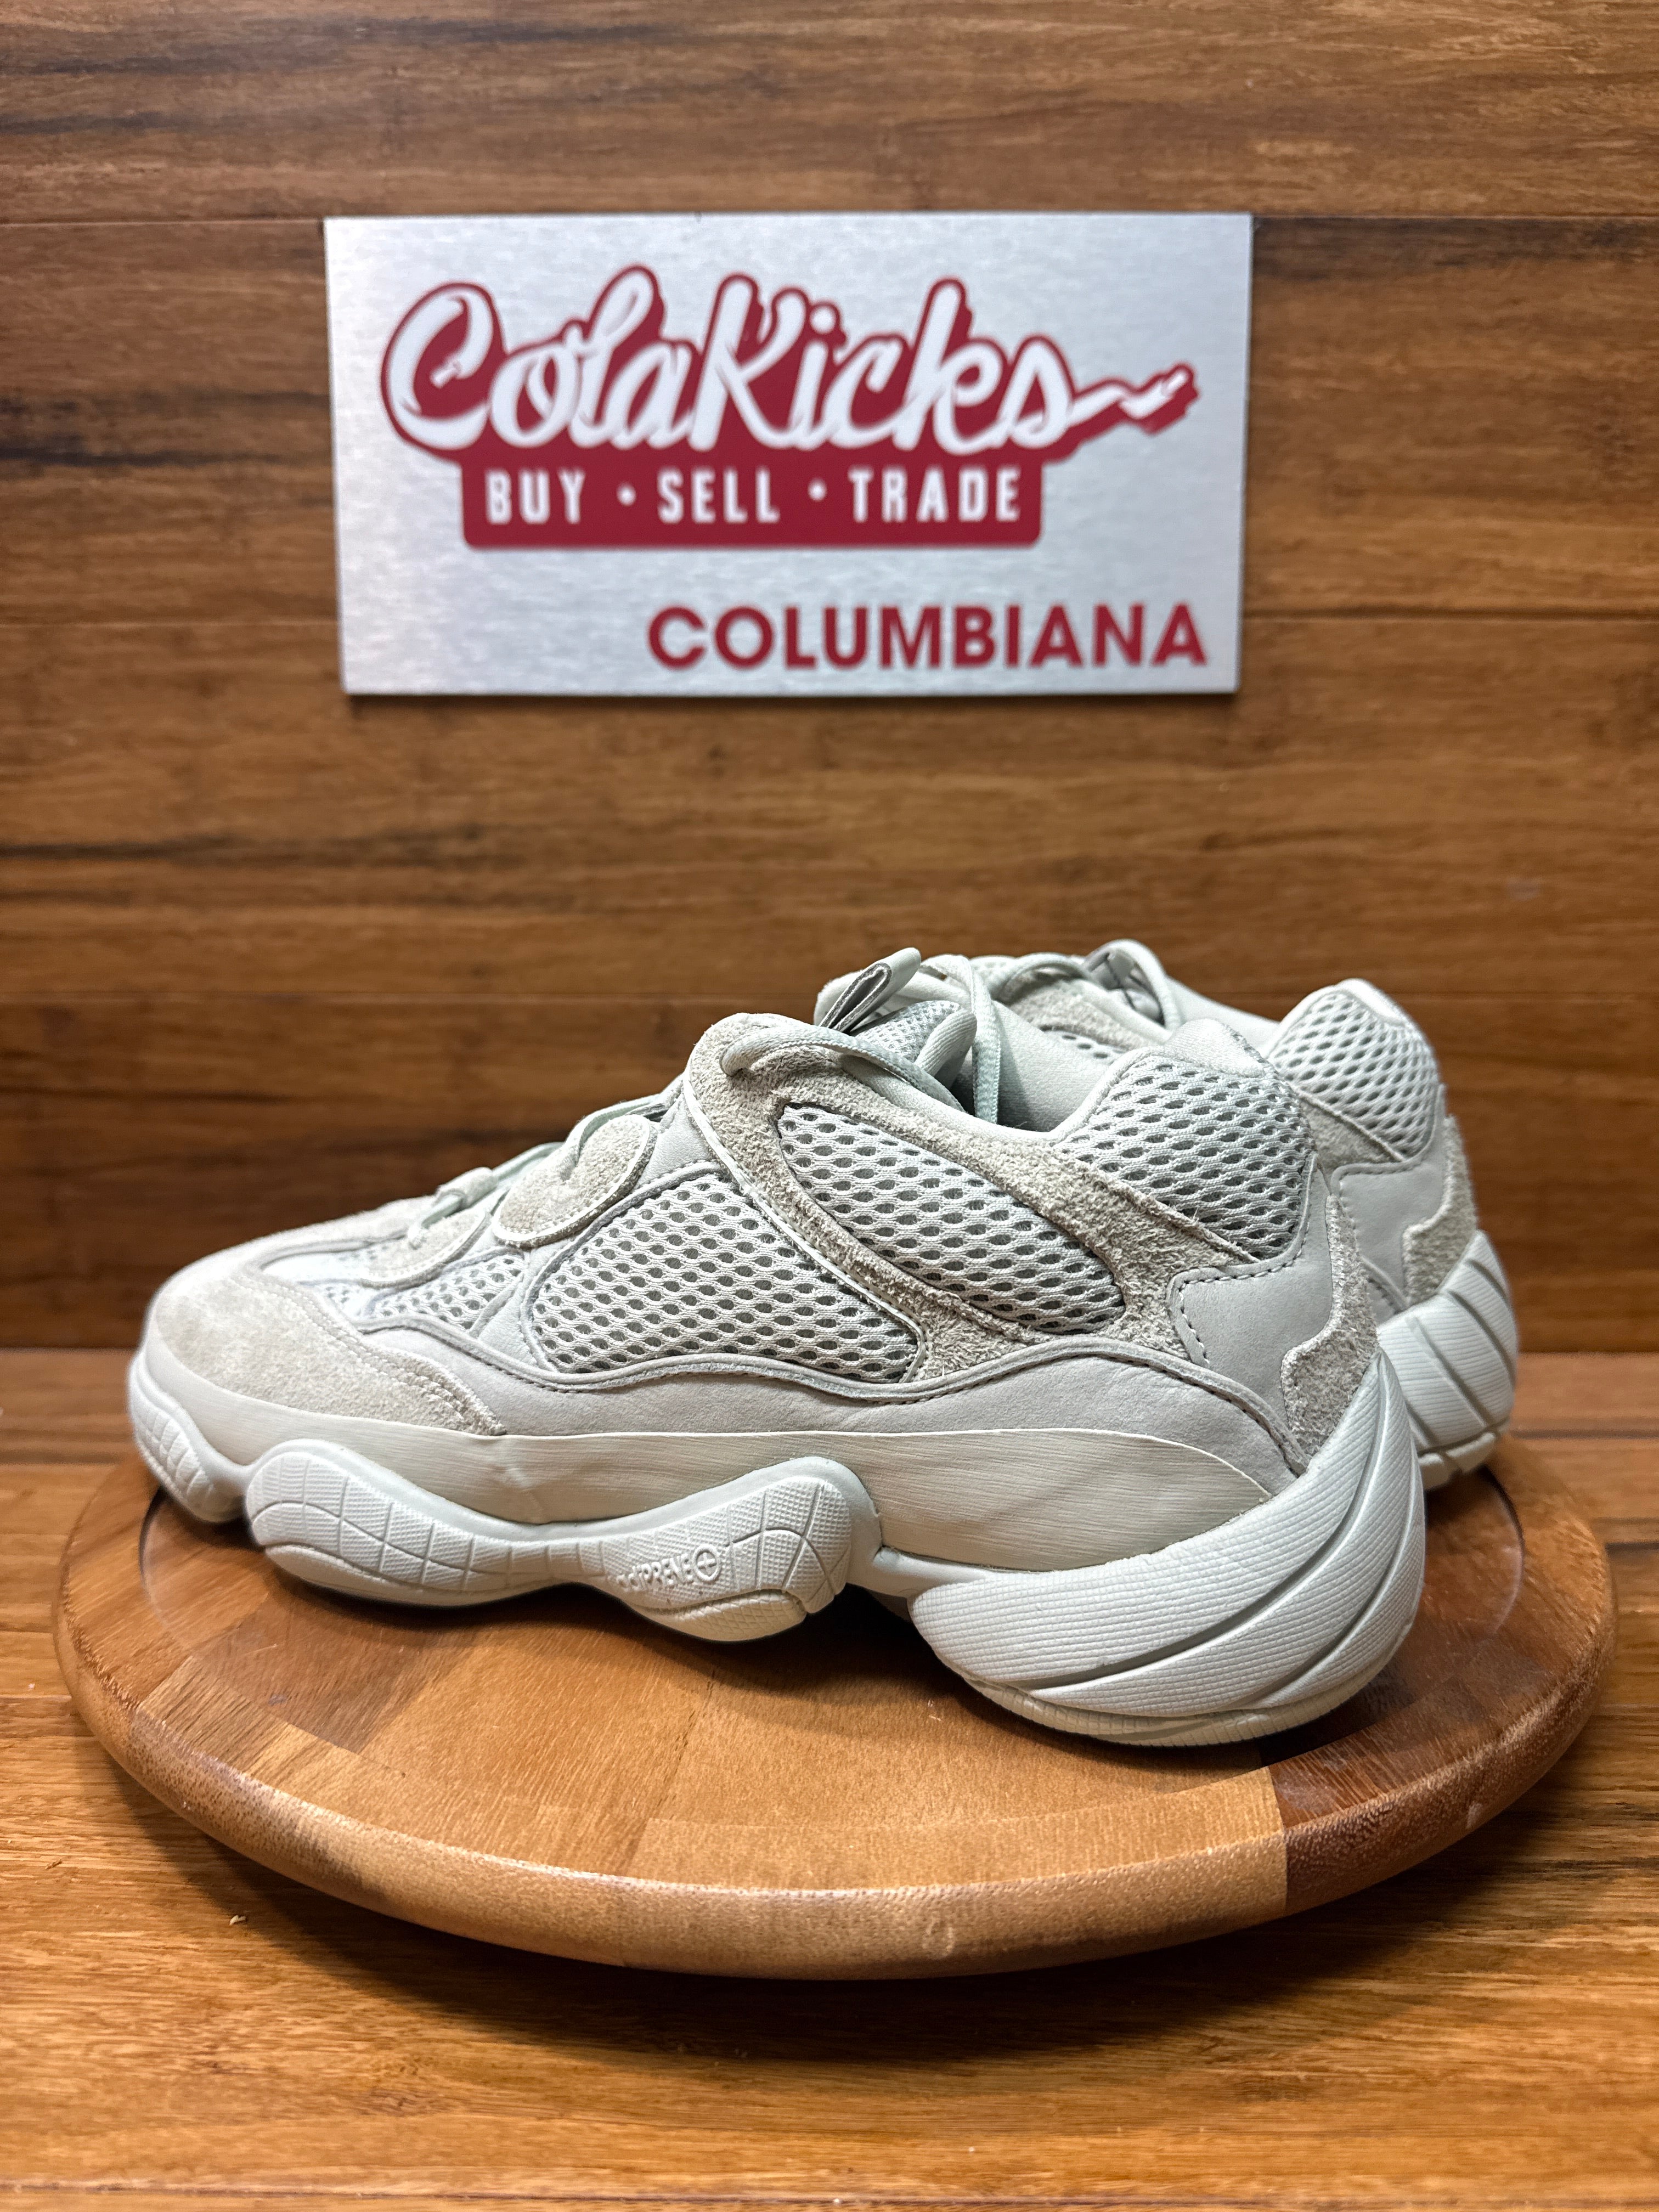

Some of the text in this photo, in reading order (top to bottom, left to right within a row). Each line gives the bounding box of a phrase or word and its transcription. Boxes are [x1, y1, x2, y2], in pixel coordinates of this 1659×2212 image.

[383, 266, 1197, 455] ColaKicks
[485, 465, 1021, 524] BUY SELL TRADE
[647, 604, 1207, 670] COLUMBIANA
